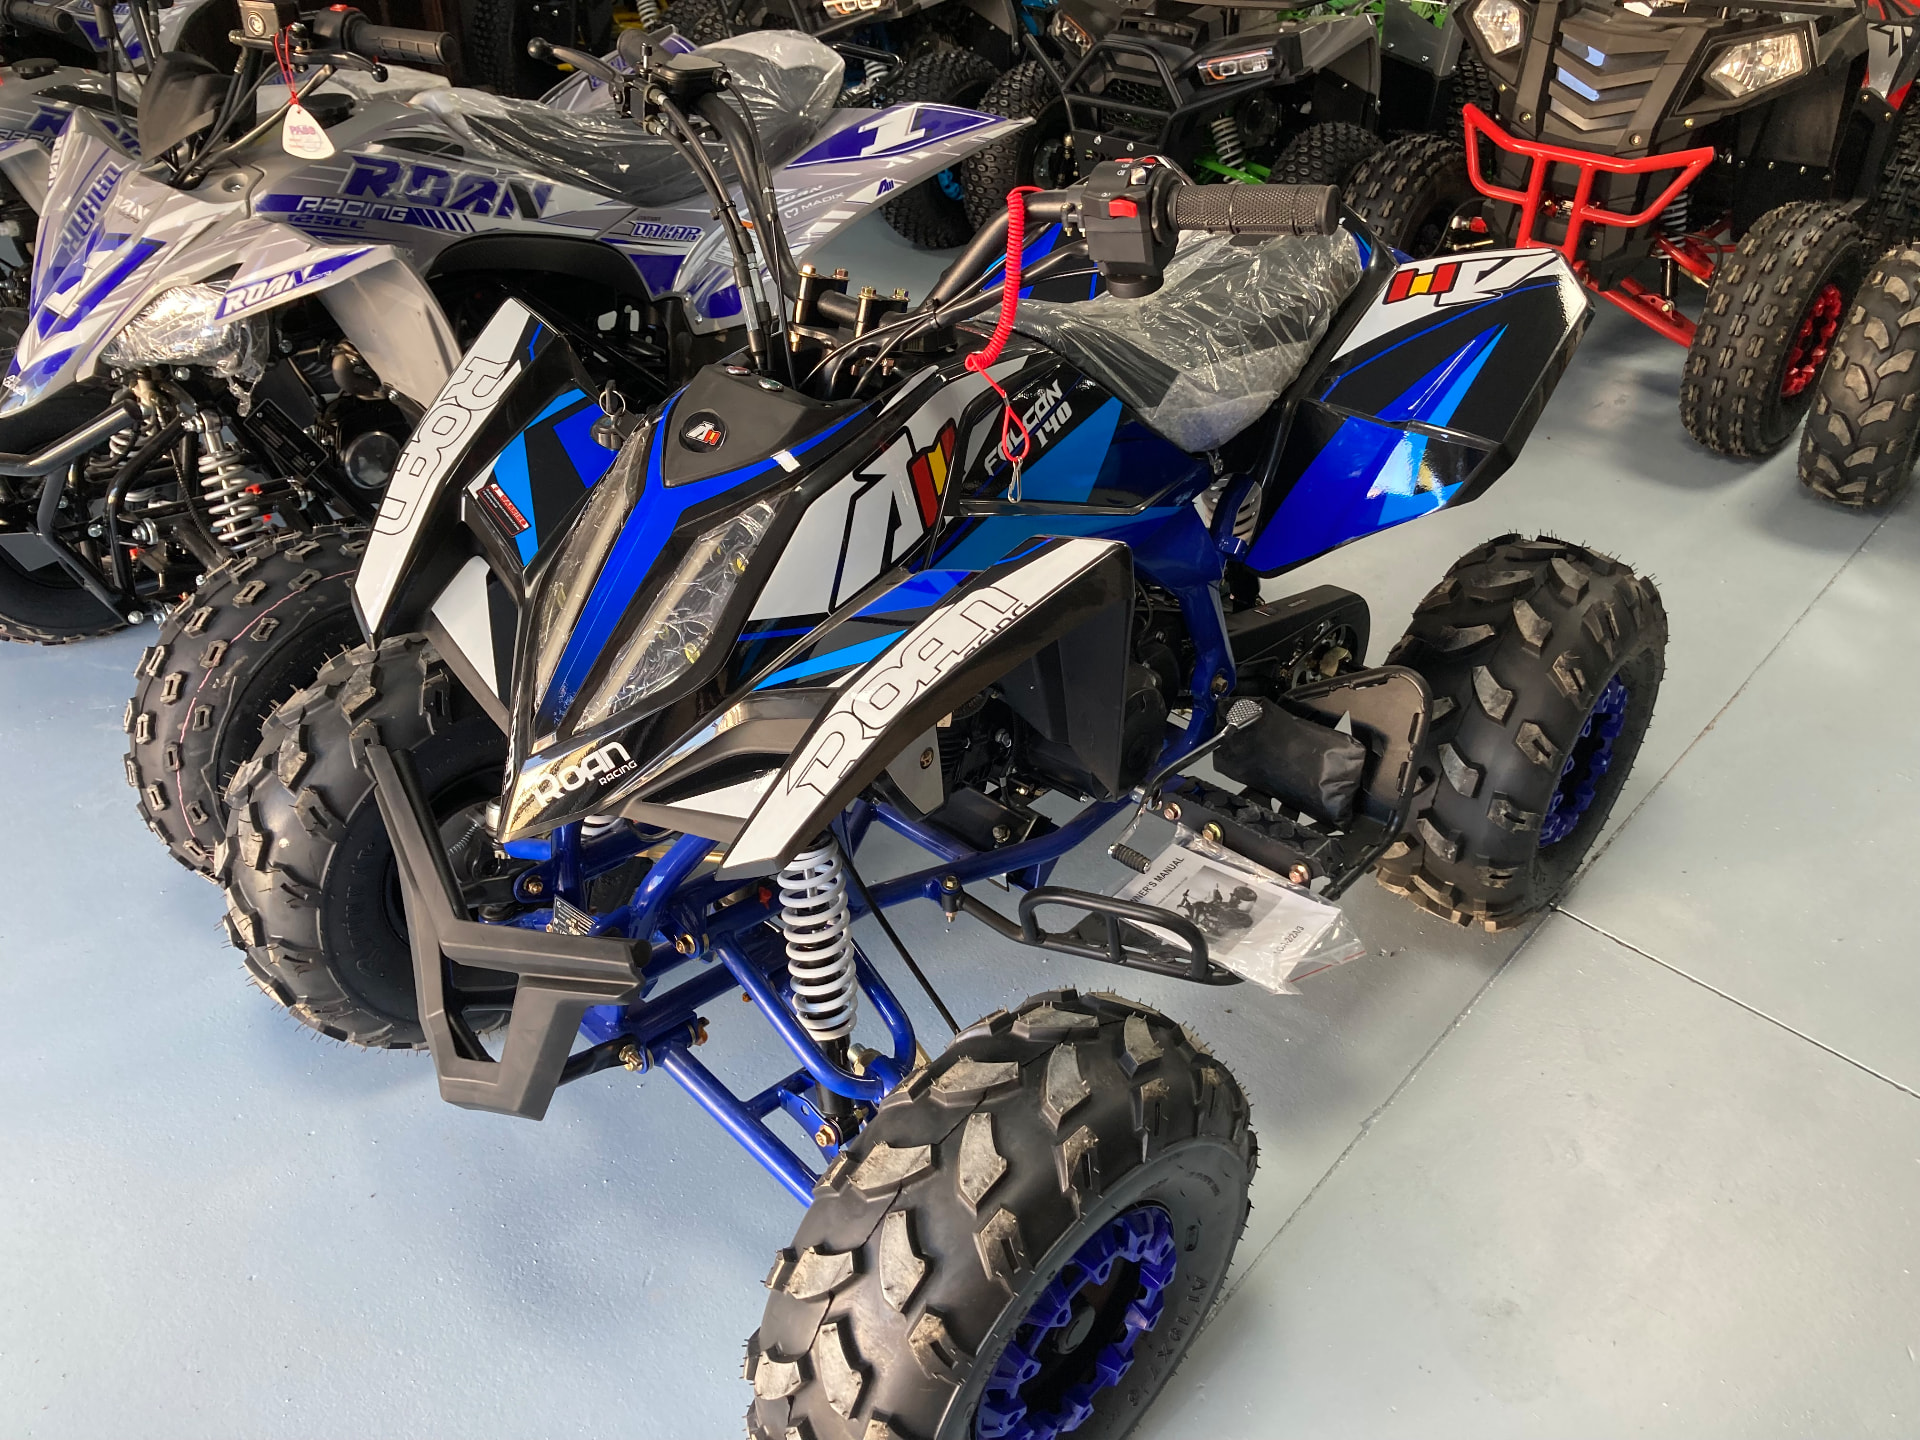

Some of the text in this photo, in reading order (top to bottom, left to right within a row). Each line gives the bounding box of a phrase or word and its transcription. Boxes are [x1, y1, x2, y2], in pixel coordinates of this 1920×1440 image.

[338, 155, 554, 219] ROAN
[801, 192, 844, 210] MADIX
[296, 196, 408, 221] RACING
[631, 221, 703, 242] DAKAR
[222, 264, 314, 316] ROAN
[984, 379, 1064, 477] FALCON
[1035, 401, 1073, 449] 140
[531, 741, 631, 808] ROAN
[598, 761, 638, 786] RACING
[1153, 857, 1185, 883] MANUAL
